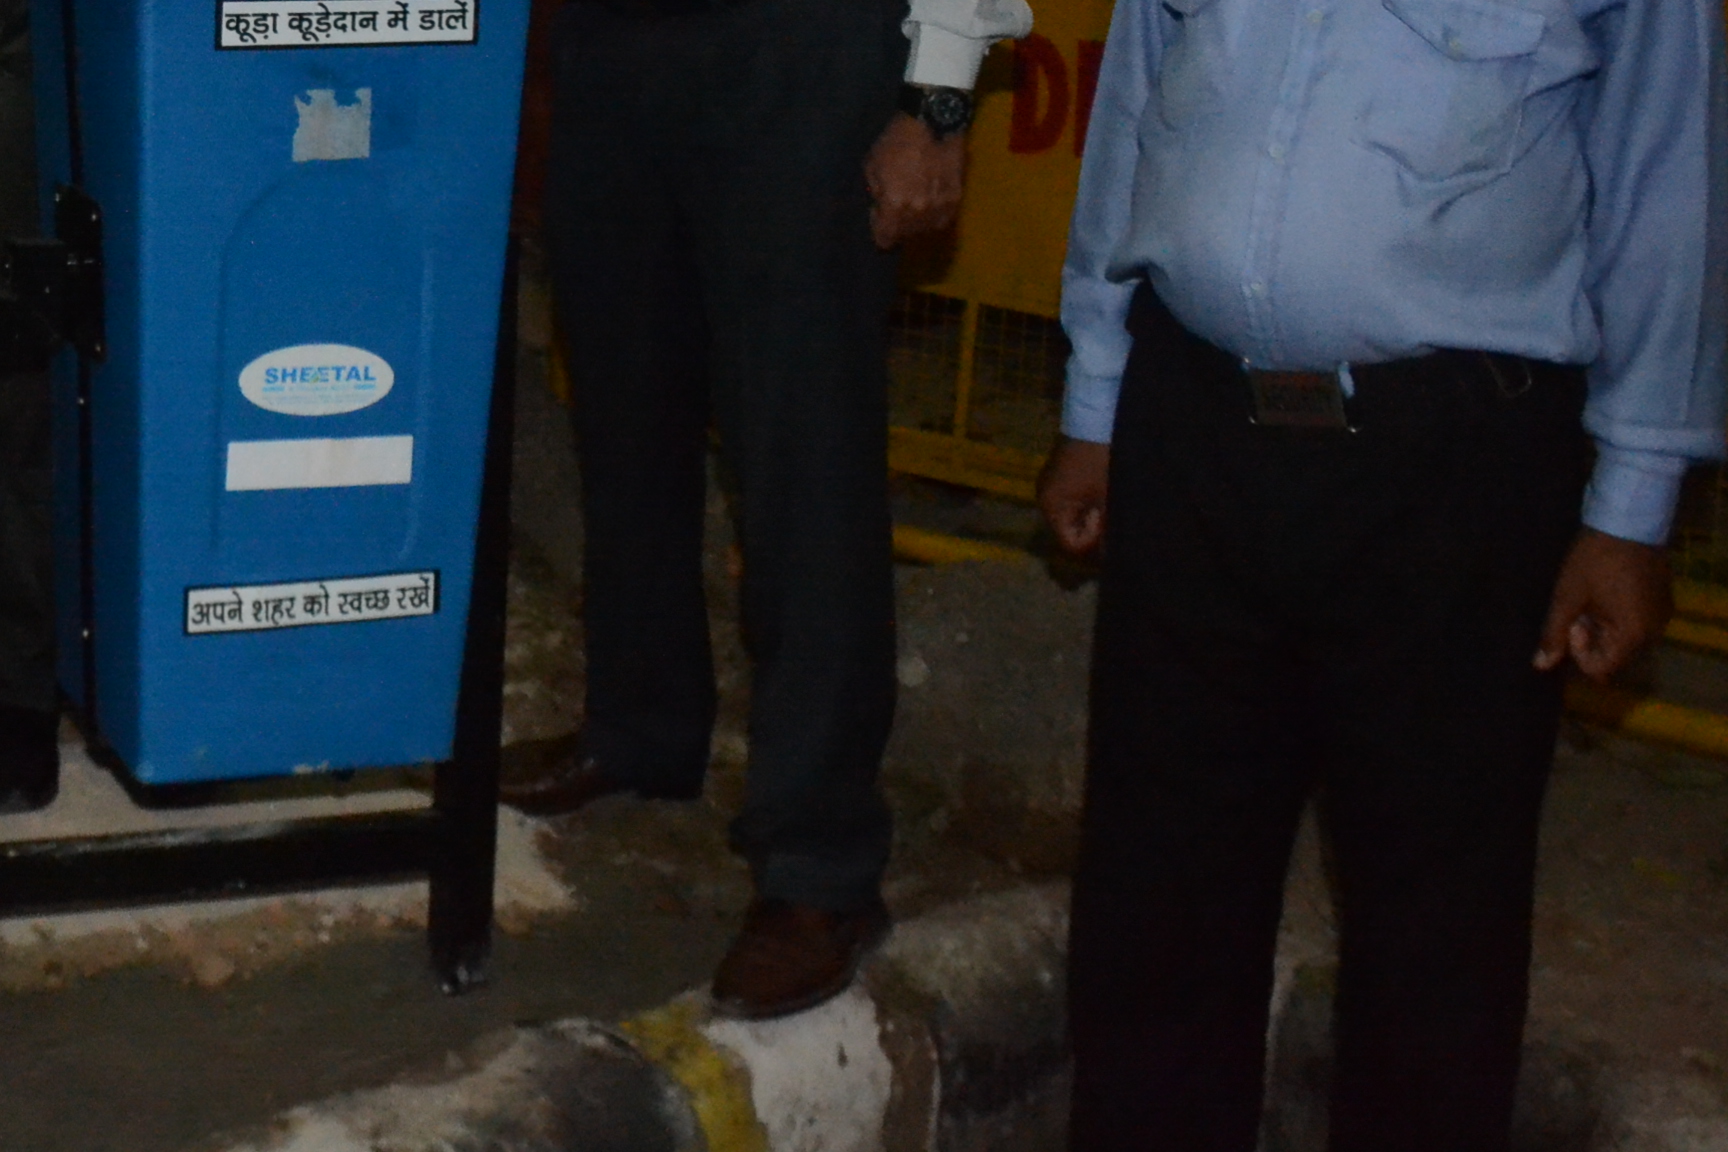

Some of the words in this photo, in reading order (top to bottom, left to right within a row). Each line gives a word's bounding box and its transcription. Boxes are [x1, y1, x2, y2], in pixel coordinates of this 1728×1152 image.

[225, 12, 279, 44] कूड़ा
[288, 1, 379, 43] कूड़ेदान
[387, 0, 410, 31] में
[418, 0, 470, 31] डालें
[264, 365, 377, 385] SHEETAL
[191, 591, 244, 626] अपने
[252, 596, 296, 627] शहर
[303, 584, 330, 617] को
[337, 588, 391, 616] स्वच्छ
[397, 576, 432, 610] रखें
